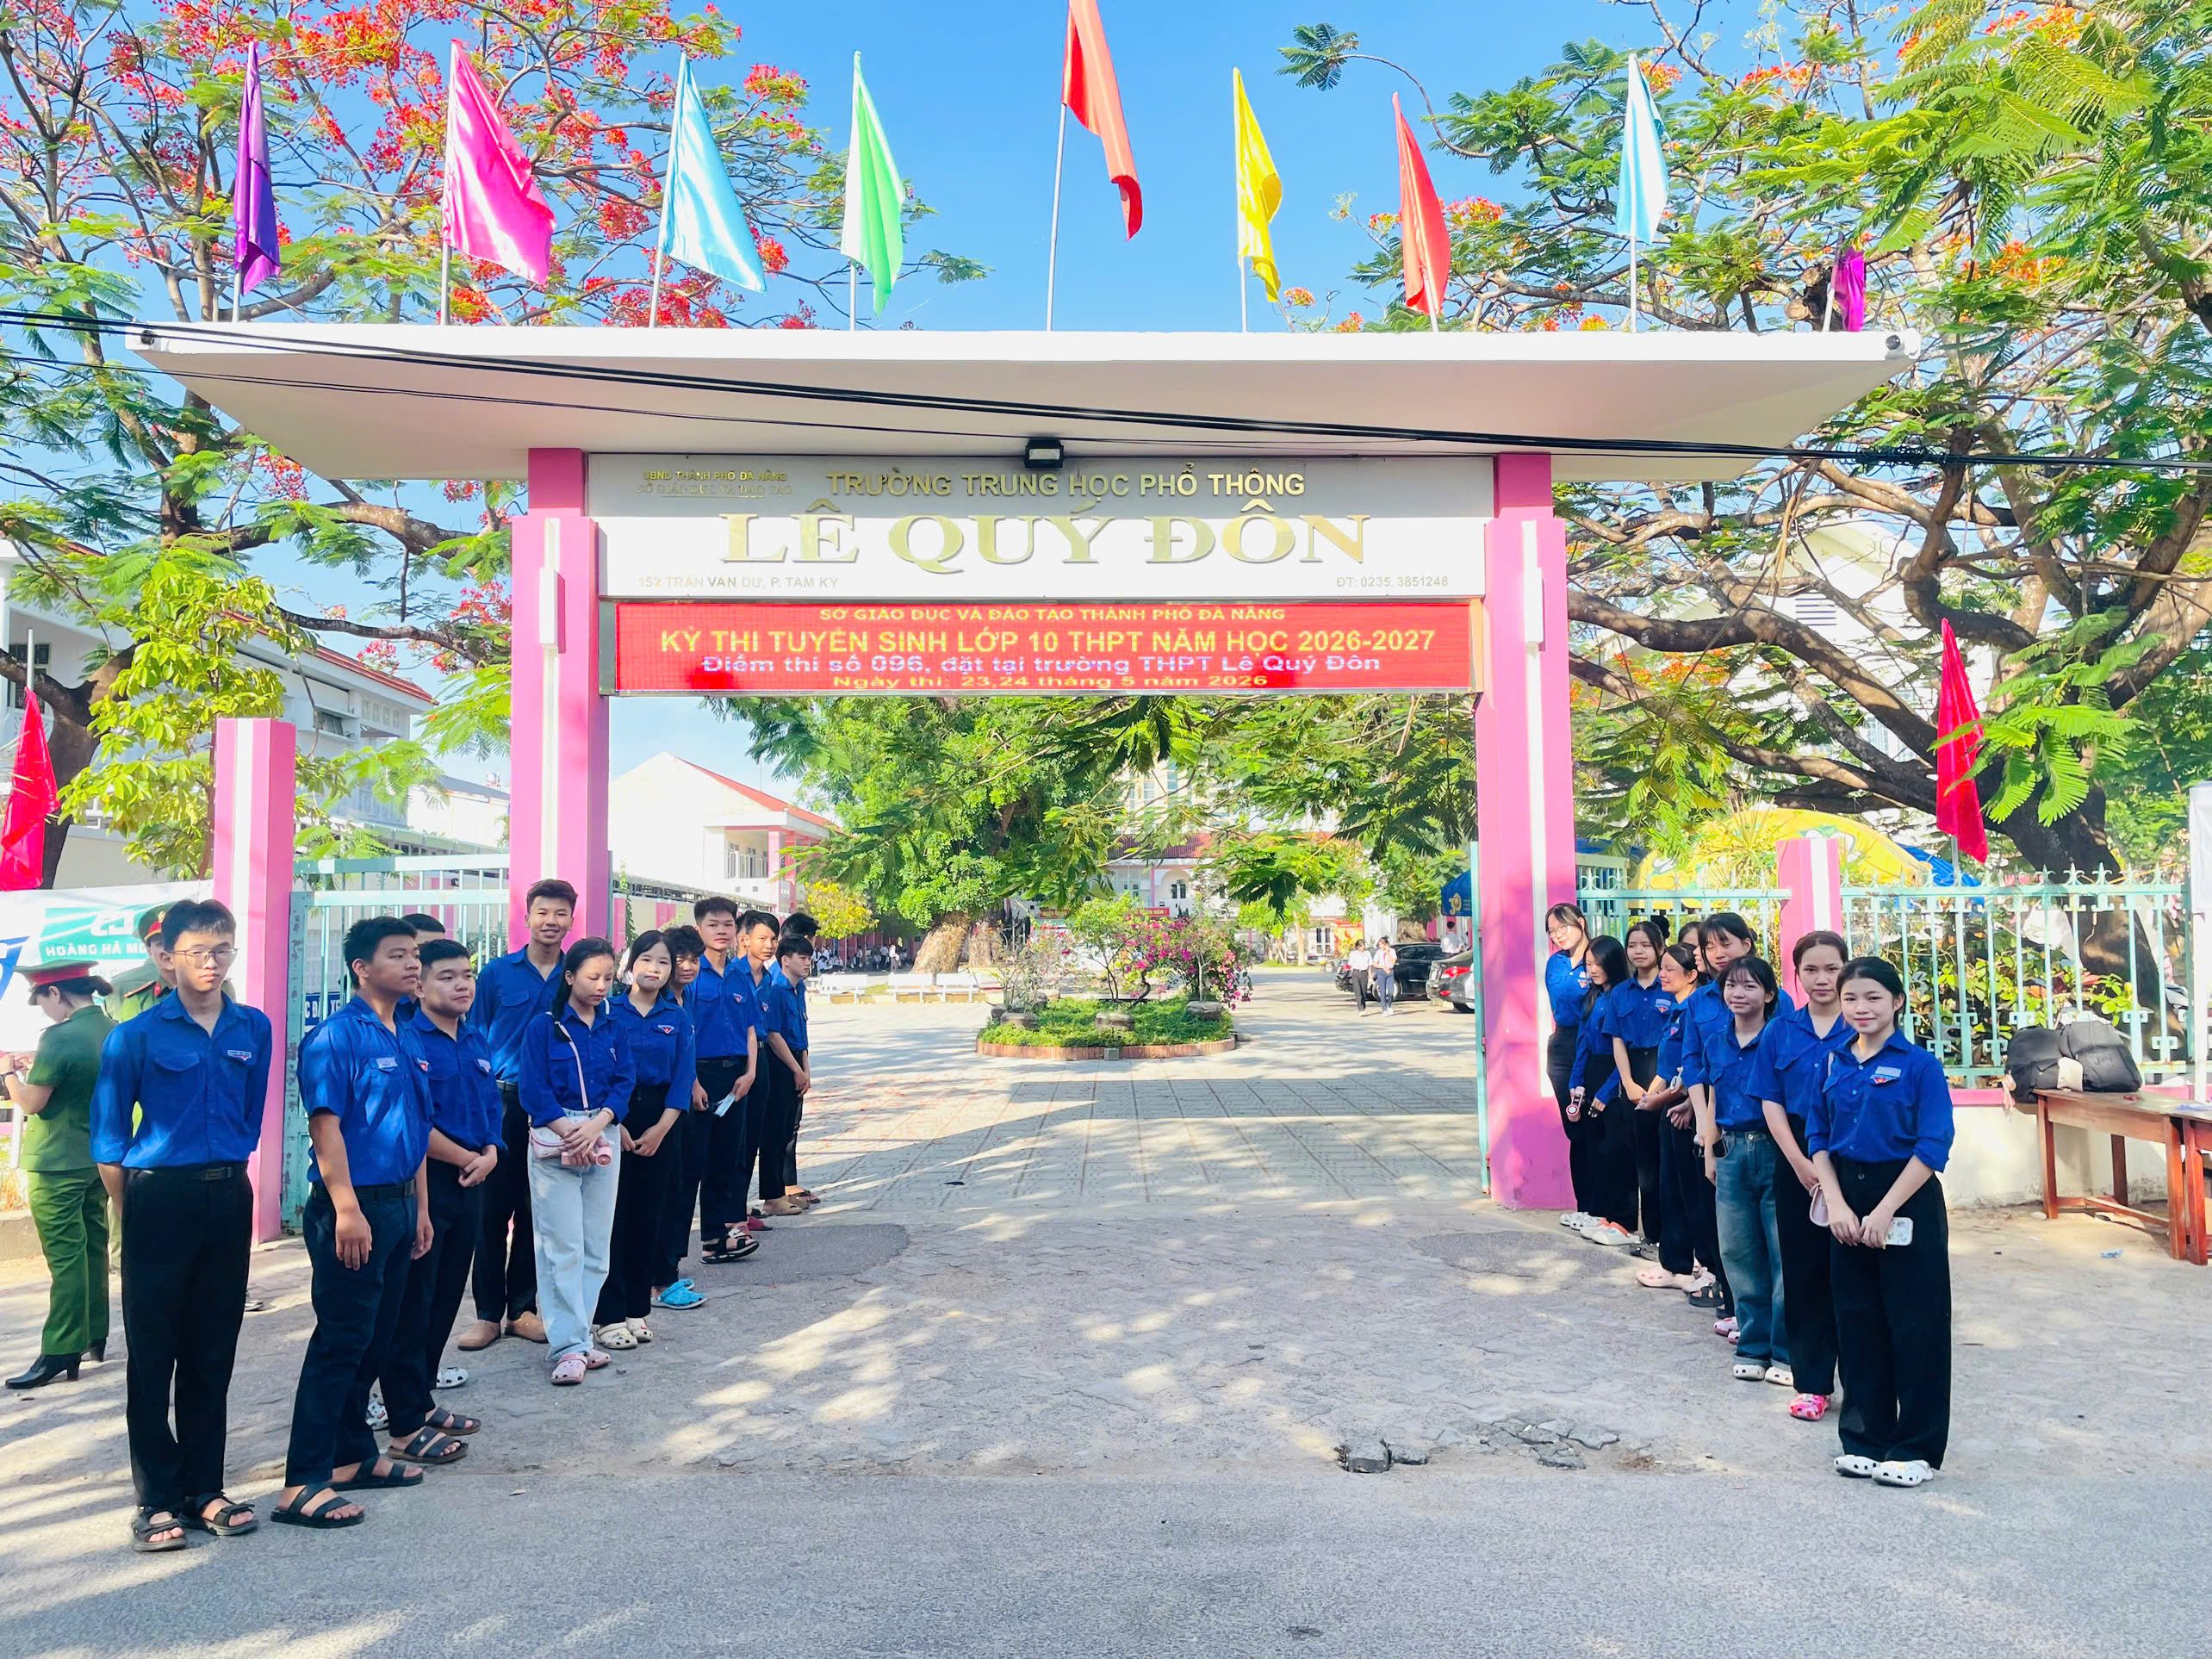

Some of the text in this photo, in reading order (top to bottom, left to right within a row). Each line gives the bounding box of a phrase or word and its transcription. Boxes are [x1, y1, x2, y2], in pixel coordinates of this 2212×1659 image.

[826, 462, 1305, 502] TRƯỜNG TRUNG HỌC PHỔ THÔNG
[718, 498, 1370, 575] LÊ QUÝ ĐÔN
[638, 576, 662, 587] 152
[771, 576, 781, 587] P.
[786, 576, 815, 587] TAM
[1336, 576, 1358, 587] ĐT:
[1396, 575, 1449, 587] 3851248
[711, 631, 759, 652] THI
[767, 627, 868, 652] TUYỂN
[878, 631, 948, 652] SINH
[957, 626, 1018, 652] LỚP
[1028, 631, 1059, 652] 10
[1068, 631, 1143, 652] THPT
[1152, 627, 1216, 652] NĂM
[1227, 631, 1289, 657] HỌC
[1297, 630, 1436, 651] 2026-2027
[701, 654, 774, 672] Điểm
[784, 656, 819, 672] thi
[828, 654, 861, 672] số
[941, 656, 984, 674] đặt
[992, 656, 1025, 674] tại
[1033, 656, 1129, 675] trường
[1138, 656, 1212, 672] THPT
[1221, 655, 1253, 671] Lê
[1262, 655, 1318, 674] Quý
[1325, 655, 1381, 671] Đôn
[833, 676, 901, 689] Ngày
[1038, 676, 1112, 688] tháng
[1120, 676, 1135, 687] 5
[1143, 675, 1198, 687] năm
[1208, 675, 1269, 687] 2026
[46, 942, 98, 957] HOÀNG
[101, 941, 122, 954] HÀ
